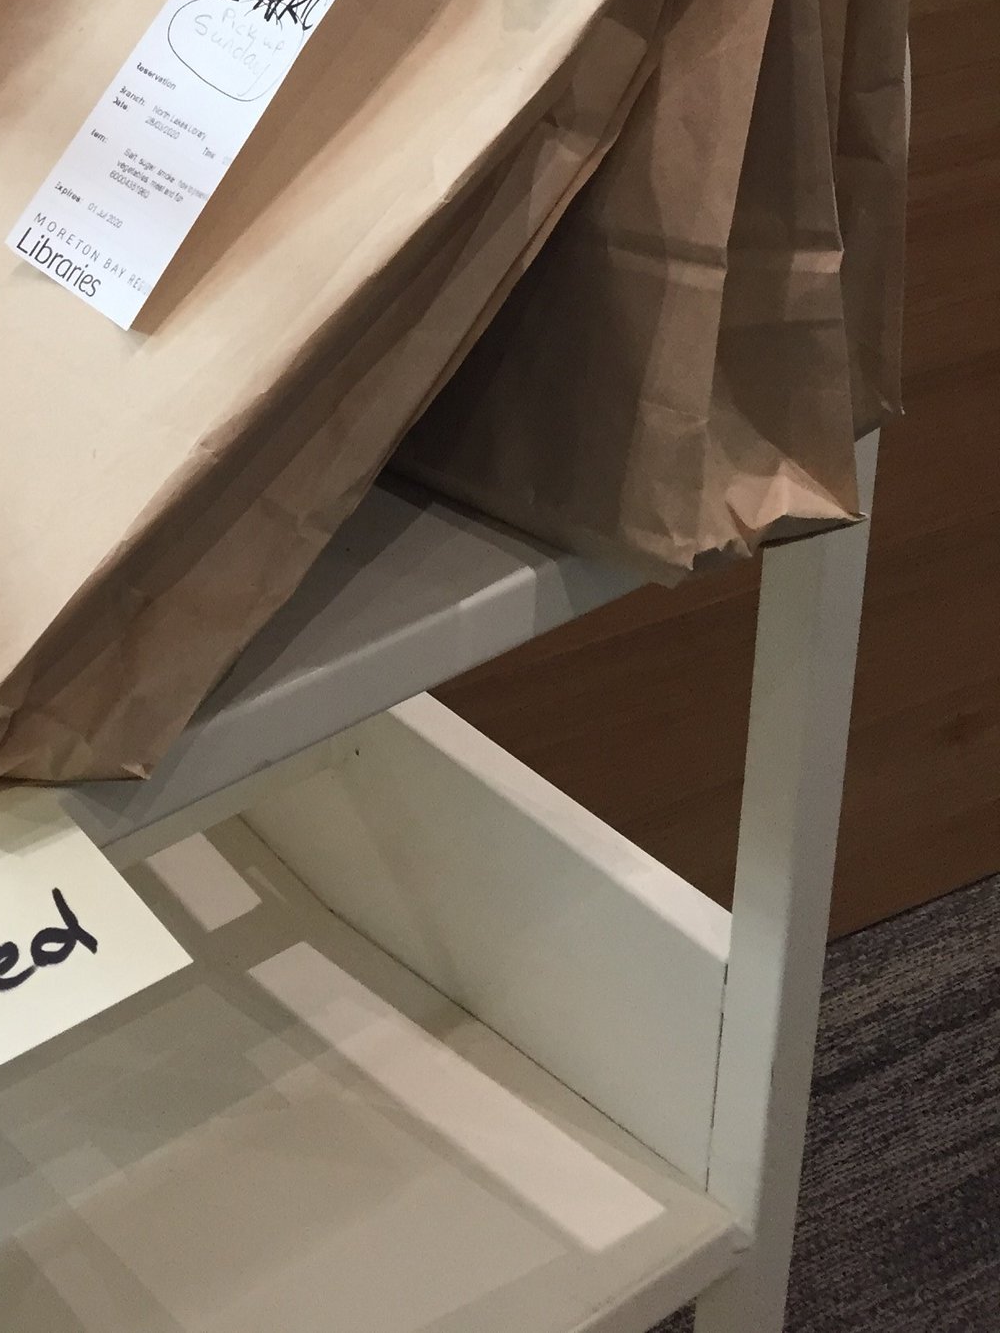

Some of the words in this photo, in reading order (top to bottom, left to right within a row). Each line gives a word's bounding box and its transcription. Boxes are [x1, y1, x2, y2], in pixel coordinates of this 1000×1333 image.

[16, 226, 102, 298] Libraries
[33, 212, 101, 262] MORETON
[104, 258, 126, 278] BAY
